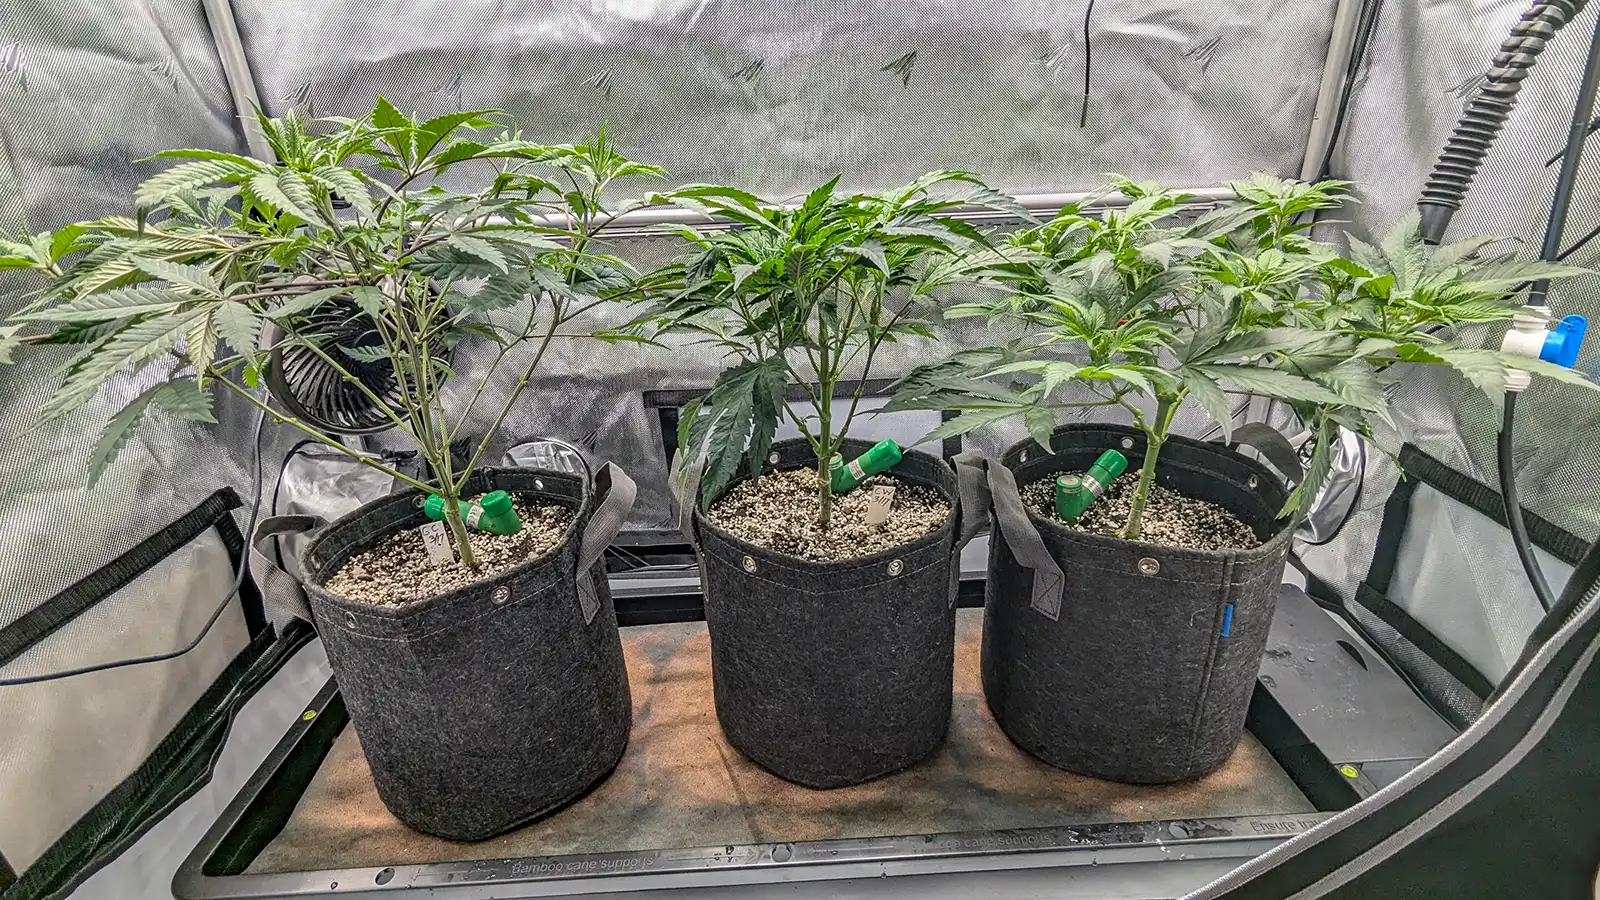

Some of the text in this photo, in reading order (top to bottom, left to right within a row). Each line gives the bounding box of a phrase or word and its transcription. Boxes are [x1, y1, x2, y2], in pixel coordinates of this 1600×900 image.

[1249, 820, 1296, 832] Ensure
[511, 860, 563, 874] Bamboo
[566, 860, 597, 871] cane
